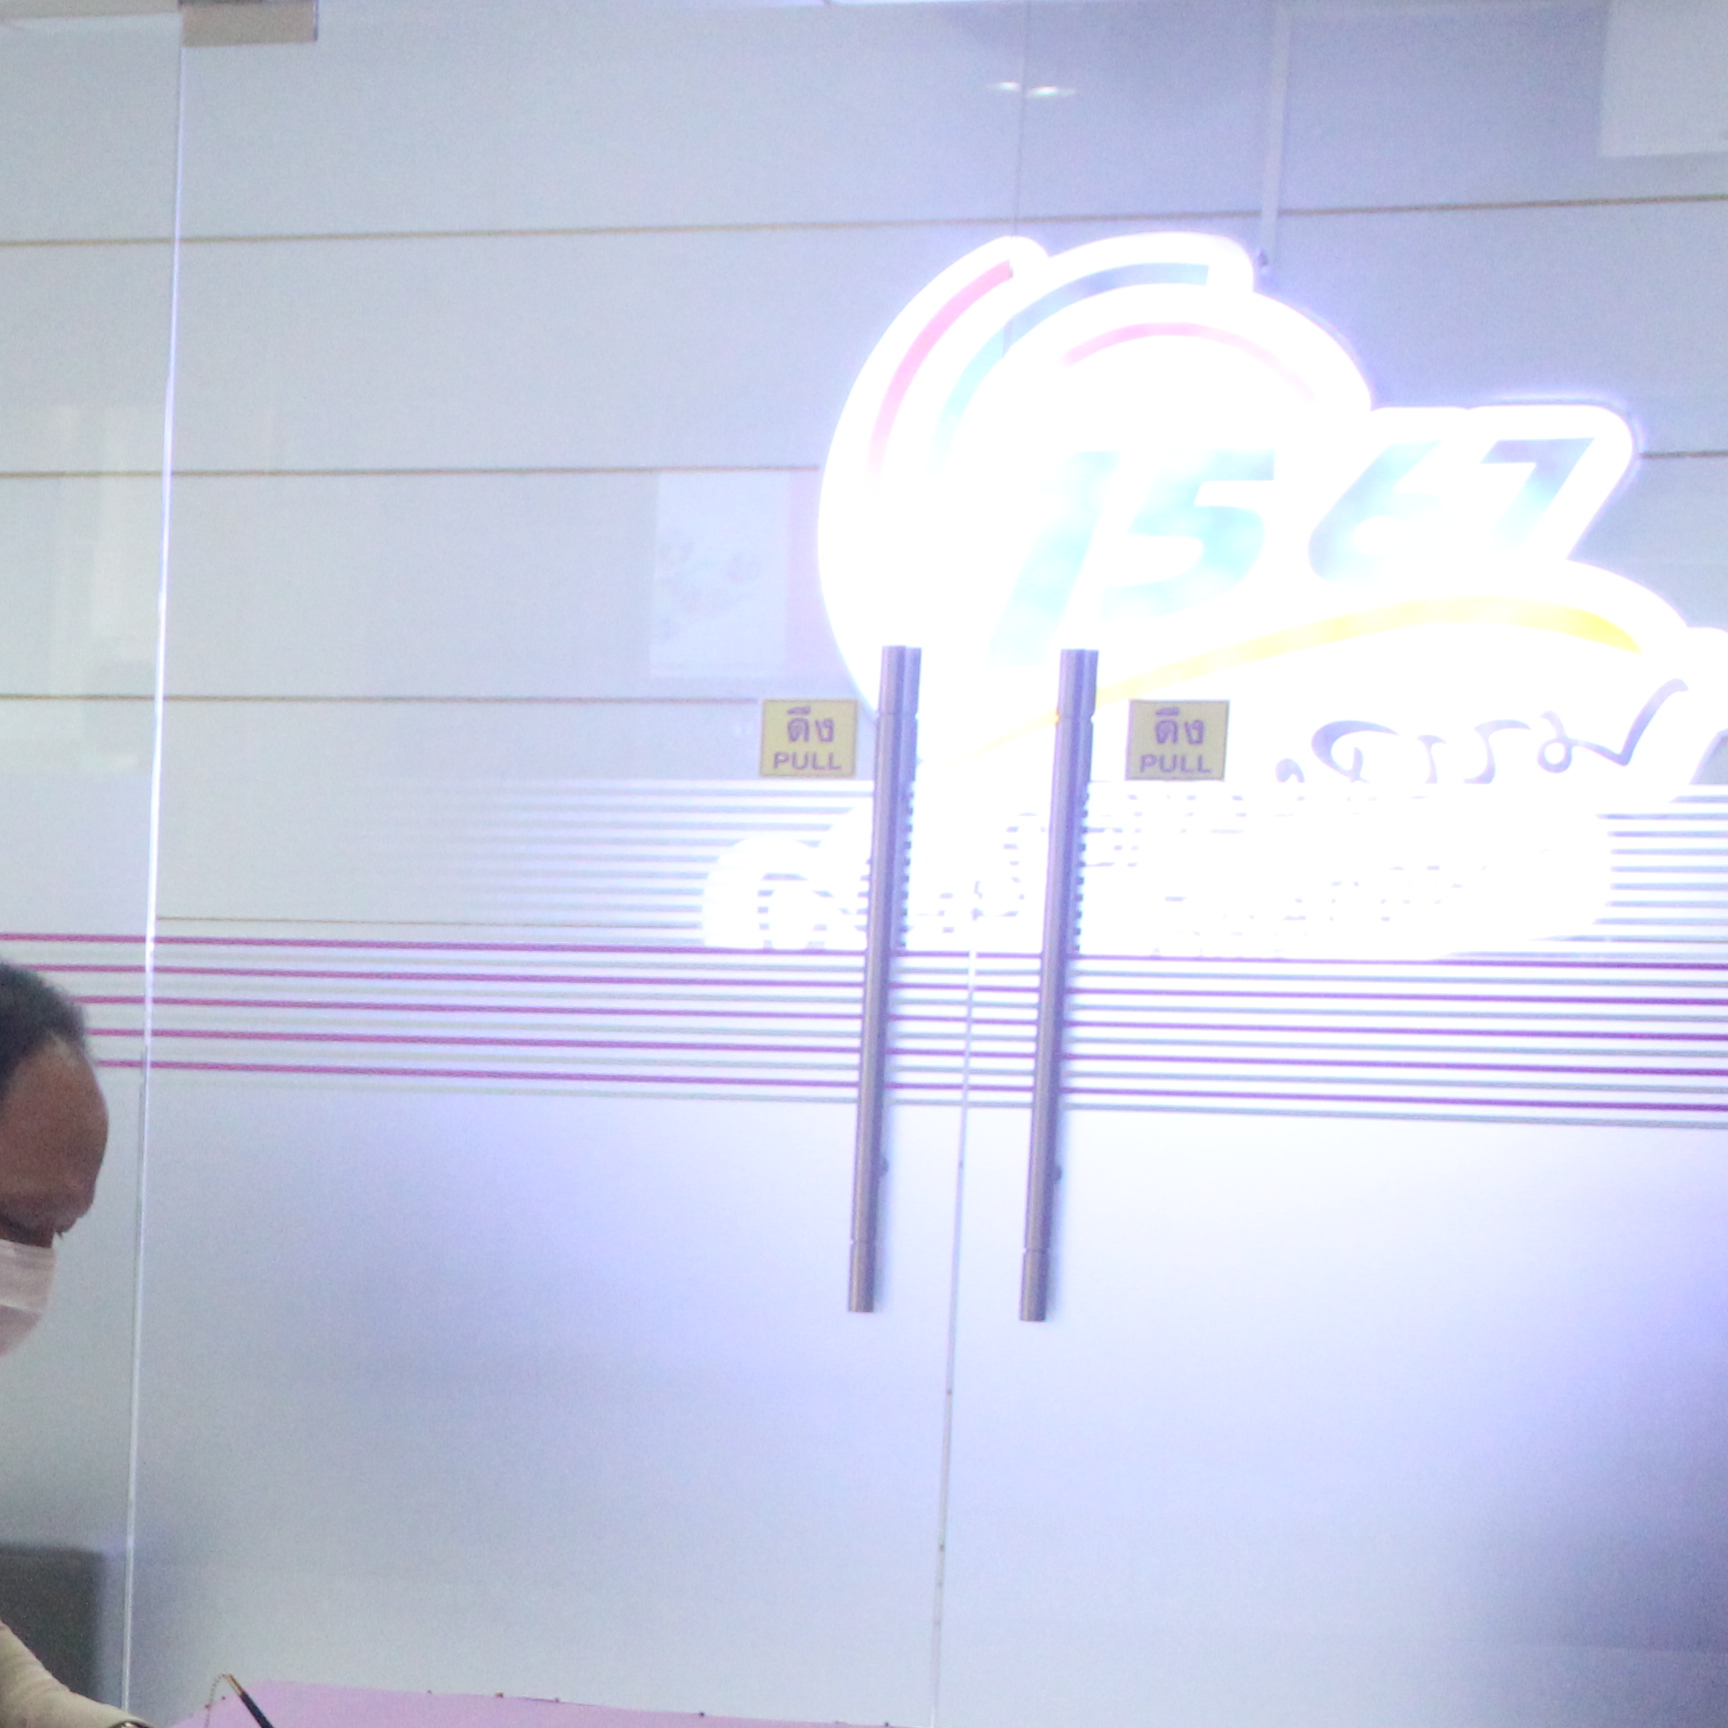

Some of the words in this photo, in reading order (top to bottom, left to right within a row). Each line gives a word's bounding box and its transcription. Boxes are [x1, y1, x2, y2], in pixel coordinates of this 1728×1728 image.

[986, 438, 1598, 667] 1567
[786, 706, 835, 743] ดึง
[1155, 706, 1205, 745] ดึง
[773, 751, 843, 770] PULL
[1139, 753, 1213, 773] PULL
